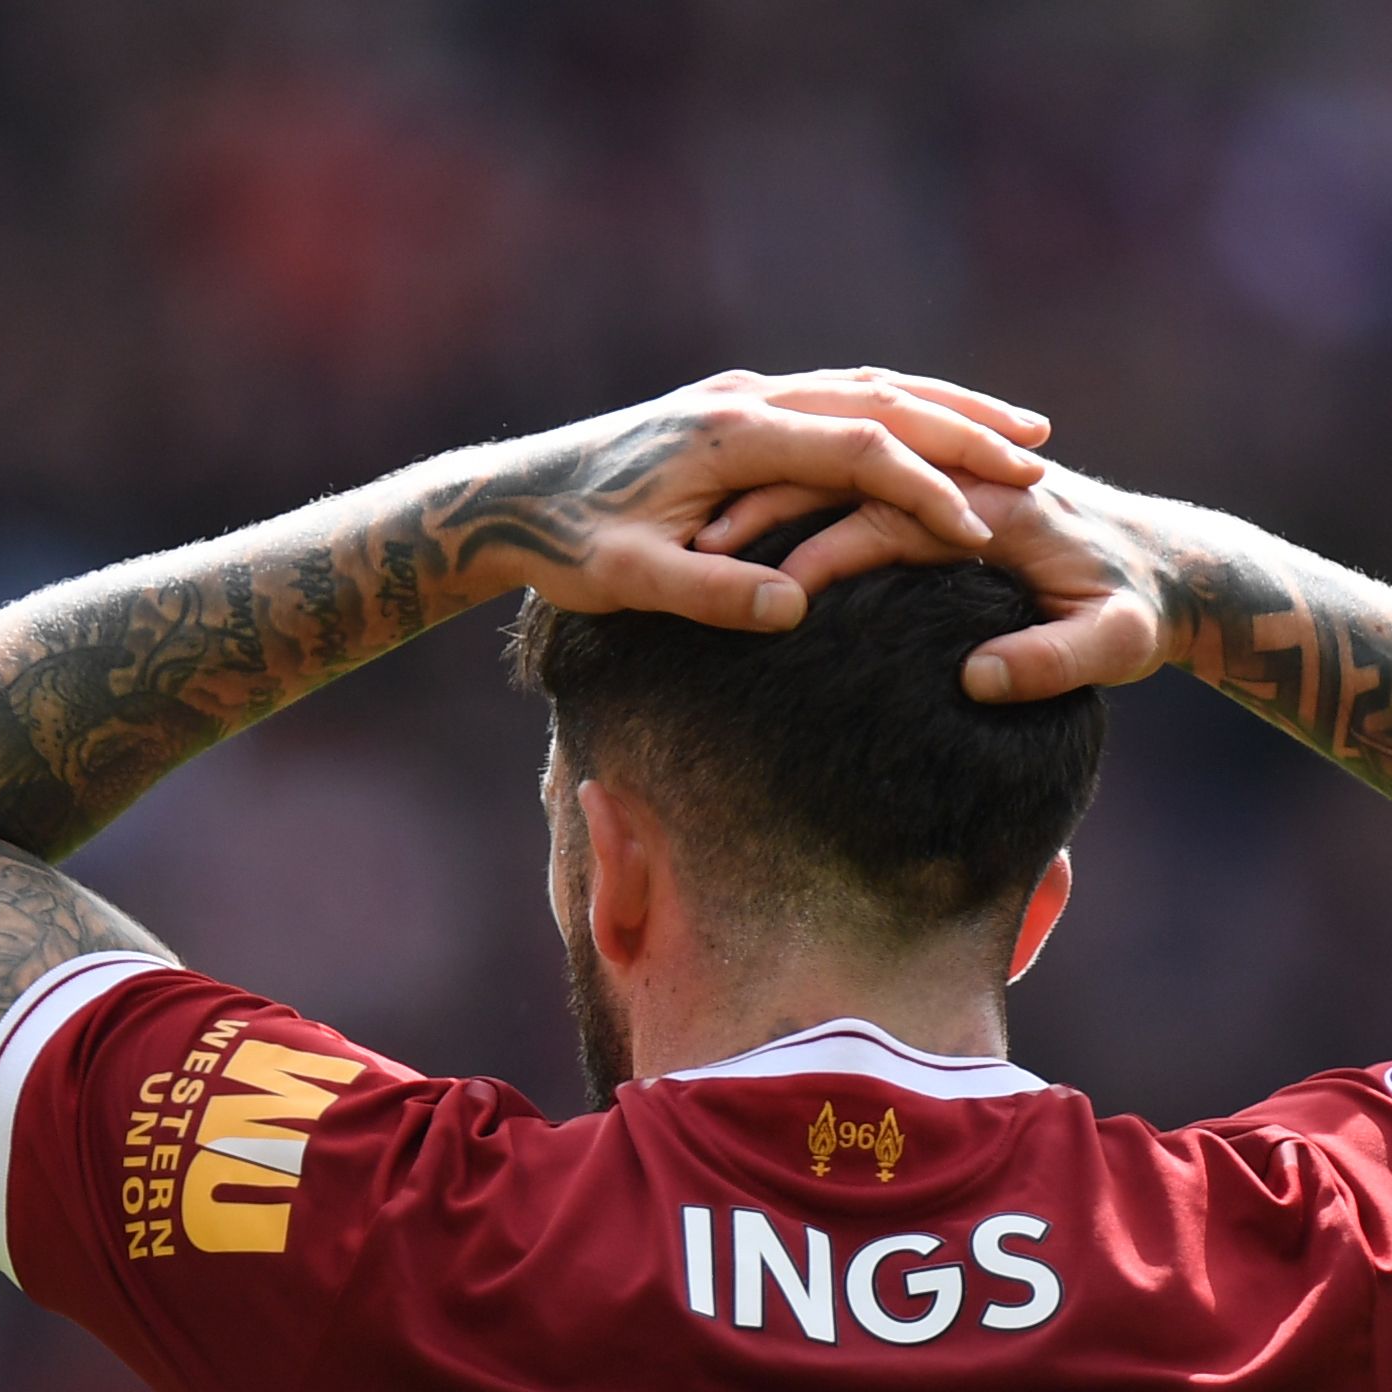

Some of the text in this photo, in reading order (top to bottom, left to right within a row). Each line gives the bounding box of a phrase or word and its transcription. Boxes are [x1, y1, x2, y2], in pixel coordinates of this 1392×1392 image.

[122, 1071, 174, 1260] UNION
[148, 1018, 250, 1258] WESTERN
[181, 1039, 368, 1253] WU
[838, 1121, 876, 1150] 96
[680, 1203, 1065, 1347] INGS
